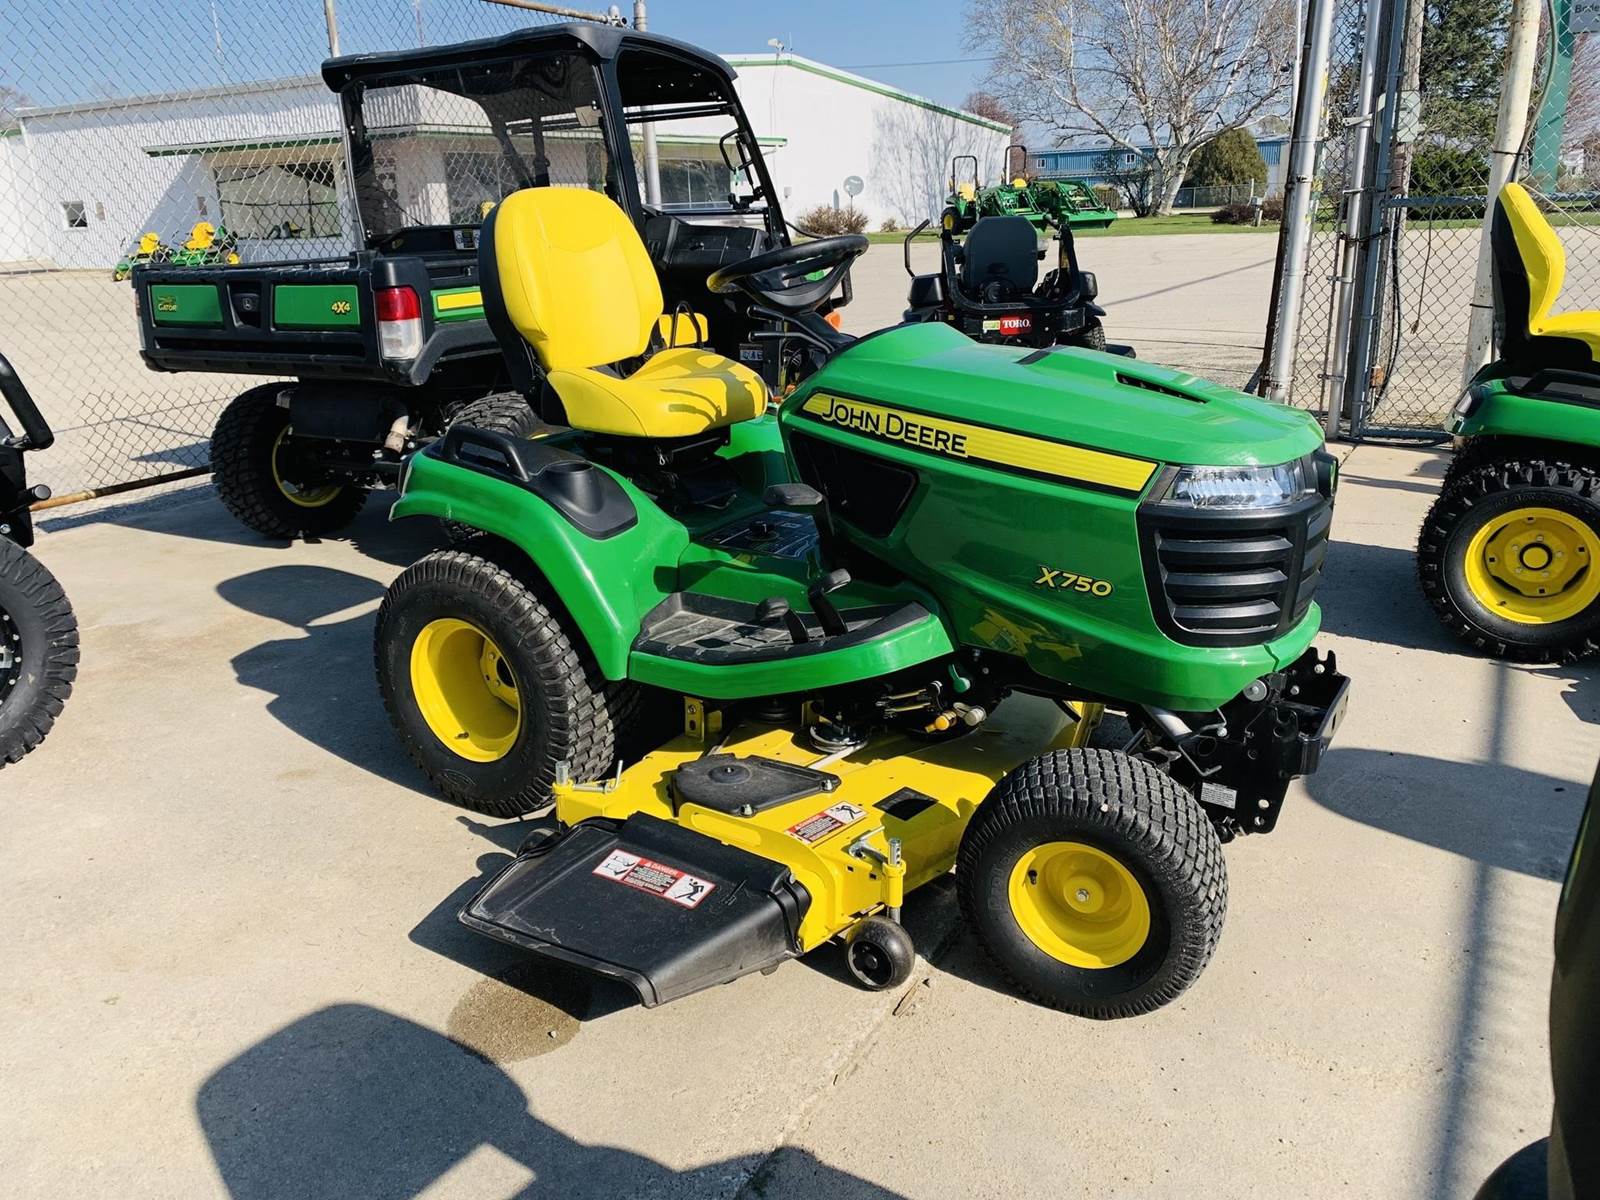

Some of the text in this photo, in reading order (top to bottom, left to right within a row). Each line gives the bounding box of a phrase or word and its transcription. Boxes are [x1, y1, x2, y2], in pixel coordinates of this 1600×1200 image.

[822, 398, 968, 455] JOHN DEERE
[1034, 567, 1112, 597] X750
